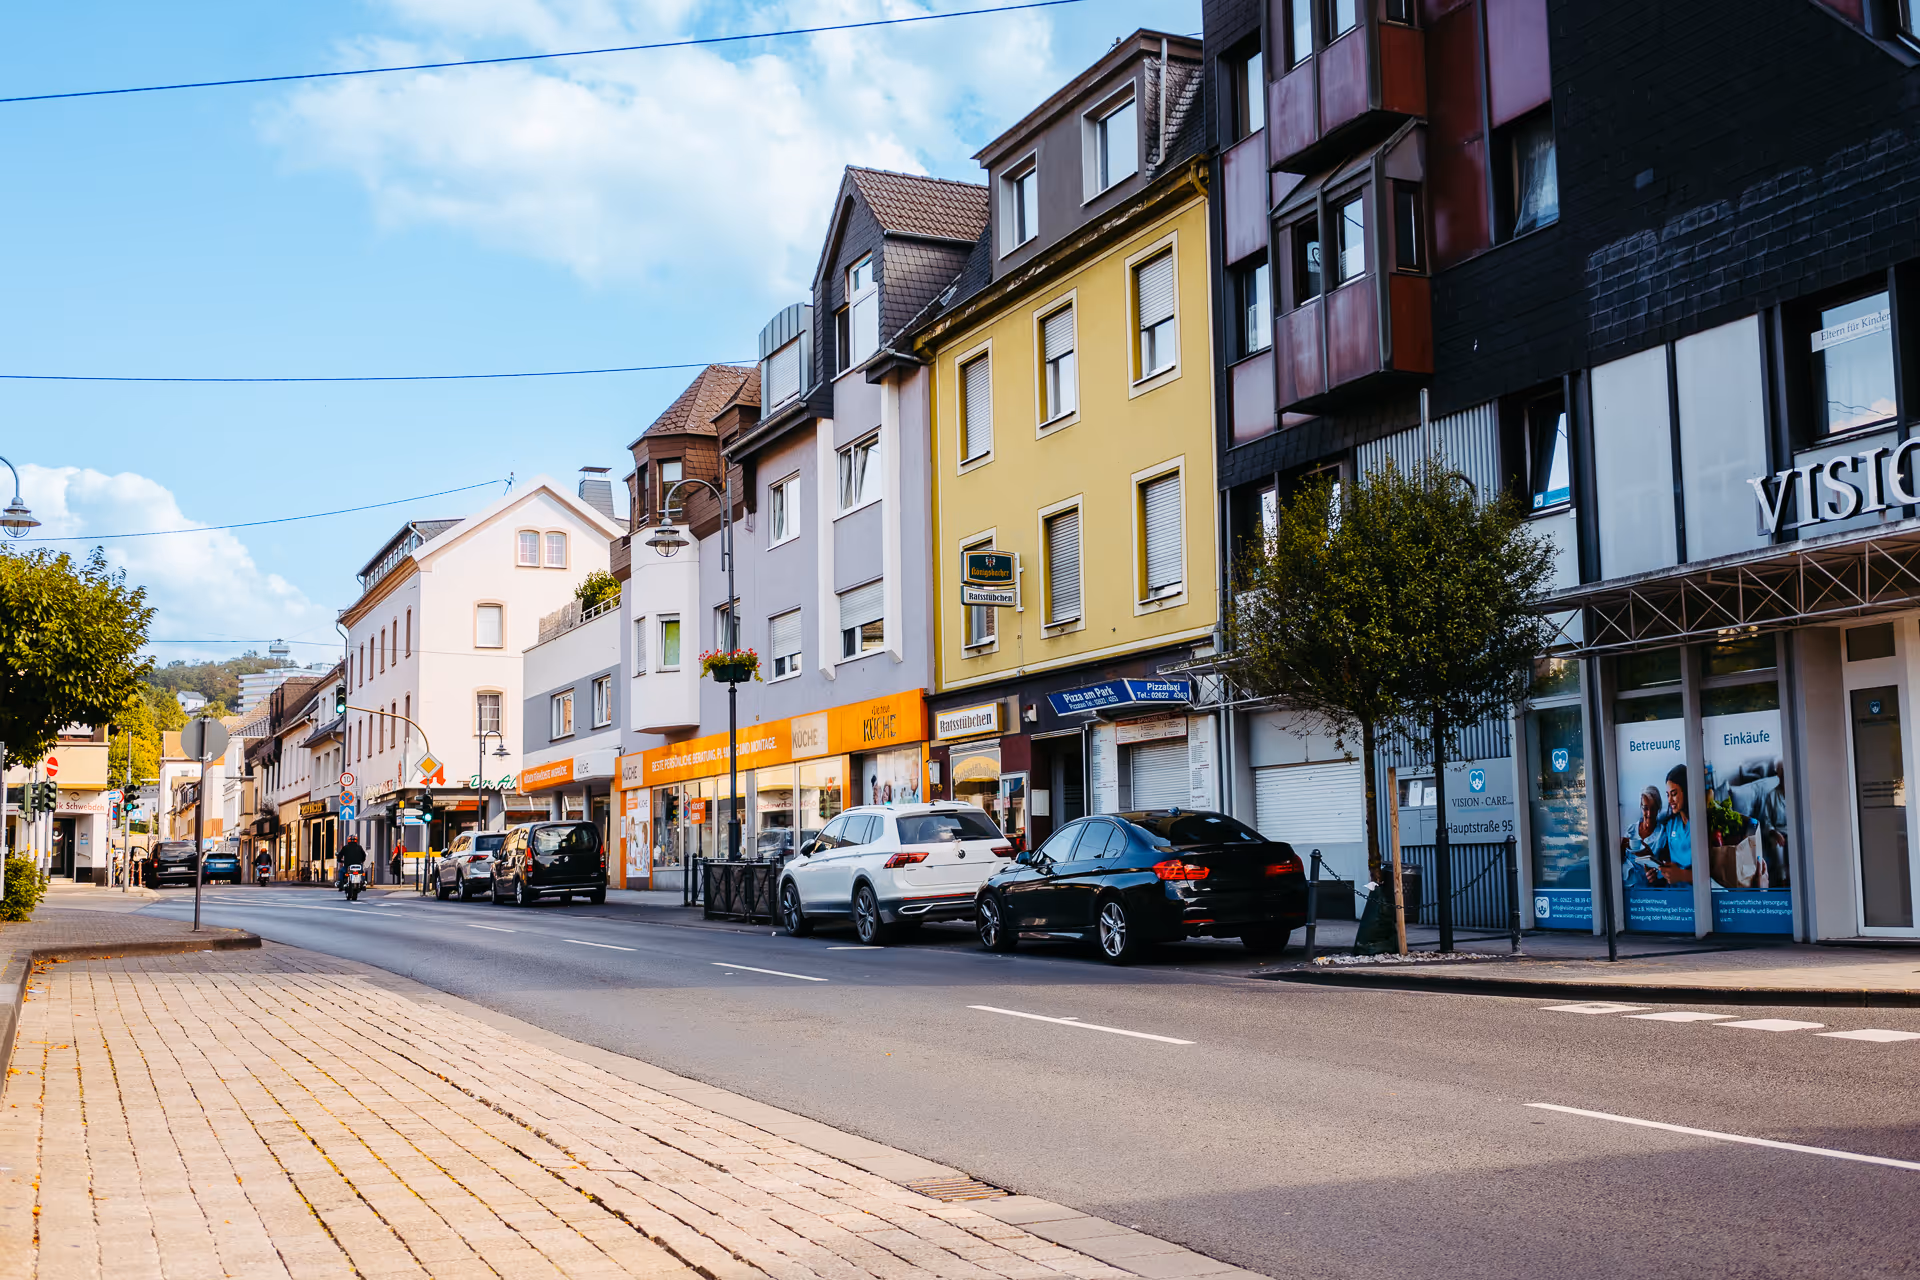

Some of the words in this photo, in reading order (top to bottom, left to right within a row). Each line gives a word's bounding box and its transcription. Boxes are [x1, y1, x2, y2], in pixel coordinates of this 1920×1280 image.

[1821, 328, 1845, 341] Eltern
[1847, 323, 1859, 333] für
[1861, 311, 1890, 328] Kinder
[971, 567, 1009, 578] Königsbacher
[968, 592, 1013, 602] Ratsstübchen
[1062, 693, 1084, 704] Pizza
[1083, 691, 1096, 700] am
[1094, 685, 1114, 698] Park
[1136, 691, 1150, 699] Tel.:
[1147, 682, 1180, 691] Pizzataxi
[863, 713, 897, 742] KÜCHE
[940, 712, 992, 733] Ratsstübchen
[792, 724, 818, 749] KÜCHE
[1723, 729, 1770, 746] Einkäufe
[651, 760, 665, 772] BESTE
[665, 753, 692, 770] PERSÖNLICHE
[692, 748, 716, 765] BERATUNG,
[739, 742, 750, 755] UND
[750, 736, 777, 753] MONTAGE.
[1629, 739, 1681, 752] Betreuung
[622, 762, 638, 780] KÜCHE
[470, 774, 493, 788] Dr.
[66, 801, 105, 811] Schwebach
[1452, 797, 1479, 807] VISION
[1485, 796, 1508, 806] CARE
[1447, 820, 1500, 836] Hauptstraße
[1501, 819, 1513, 832] 95
